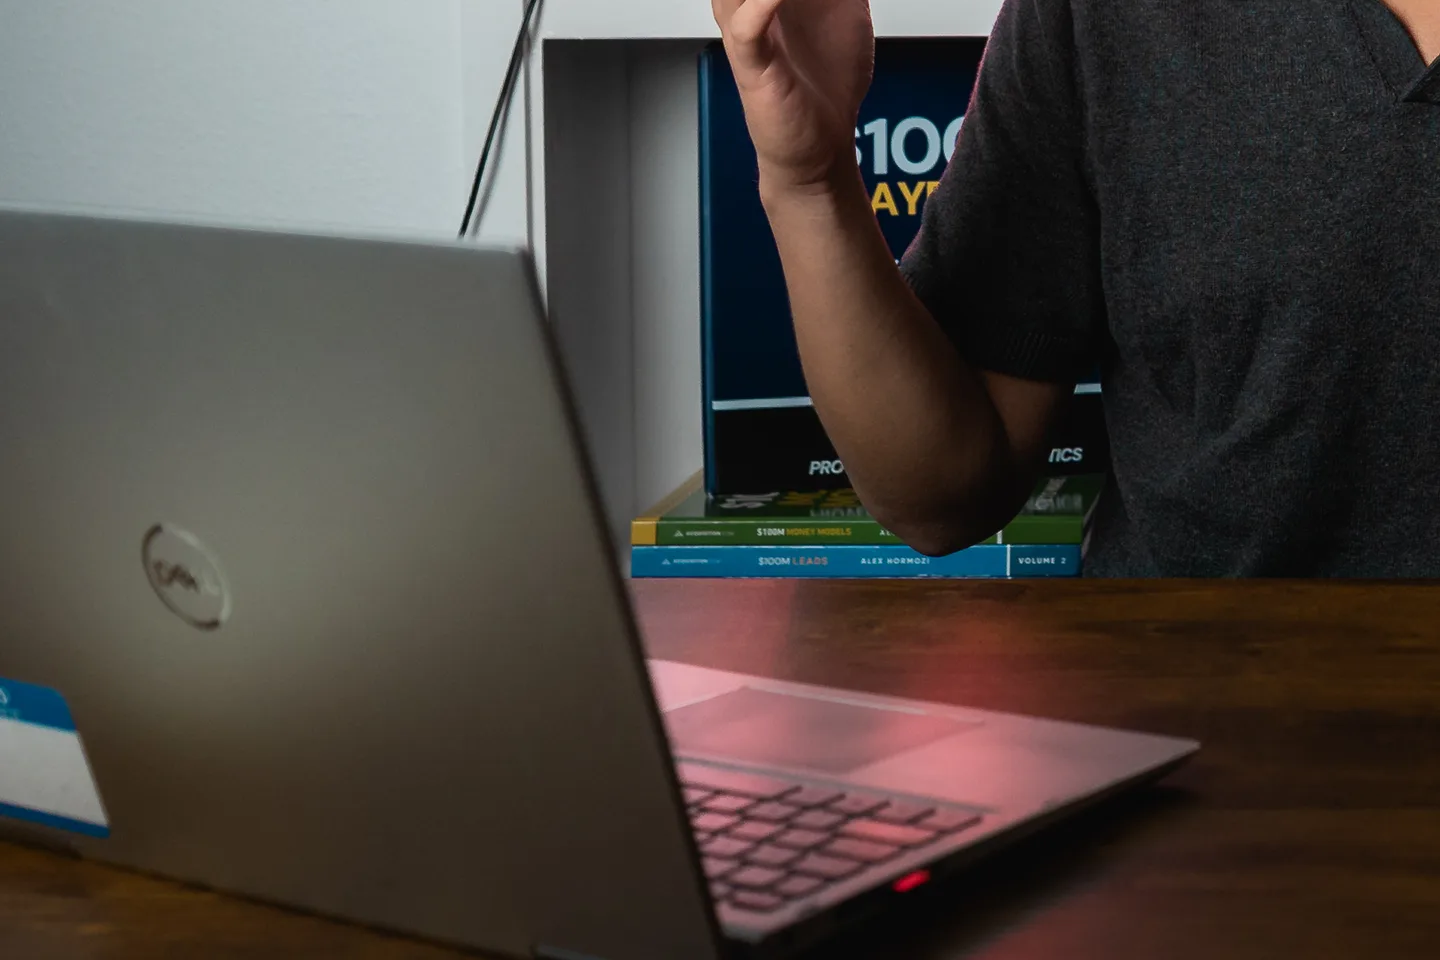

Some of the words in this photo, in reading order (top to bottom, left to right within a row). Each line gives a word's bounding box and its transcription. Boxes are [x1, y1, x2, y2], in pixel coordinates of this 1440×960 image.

[786, 528, 815, 537] MONEY
[817, 528, 852, 536] MODELS
[758, 557, 790, 566] $100M
[792, 557, 828, 566] LEADS
[1018, 557, 1055, 565] VOLUME
[1060, 557, 1067, 565] 2
